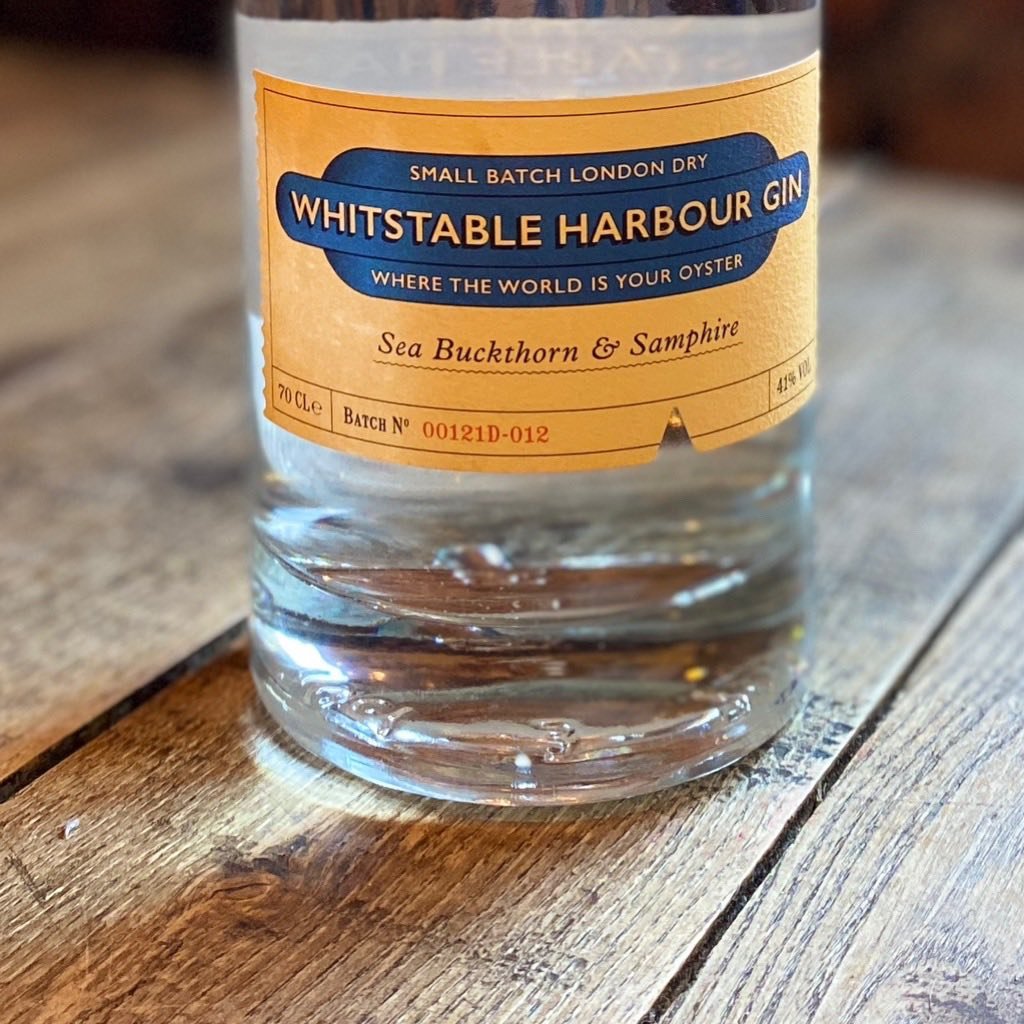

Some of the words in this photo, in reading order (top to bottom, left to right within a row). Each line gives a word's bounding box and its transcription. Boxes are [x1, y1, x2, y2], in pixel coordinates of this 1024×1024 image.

[410, 164, 478, 184] SMALL
[487, 167, 561, 185] BATCH
[570, 159, 664, 184] LONDON
[672, 152, 708, 173] DRY
[291, 190, 543, 249] WHITSTABLE
[557, 190, 752, 247] HARBOUR
[762, 168, 803, 212] GIN
[371, 269, 442, 292] WHERE
[450, 277, 491, 294] THE
[498, 275, 582, 295] WORLD
[591, 275, 608, 291] IS
[615, 269, 672, 291] YOUR
[679, 253, 744, 280] OYSTER
[377, 331, 422, 359] Sea
[433, 336, 578, 364] Buckthorn
[592, 336, 620, 359] &
[630, 317, 740, 362] Samphire
[278, 383, 292, 405] 70
[777, 370, 796, 394] 41%
[423, 420, 549, 444] 00121D-012
